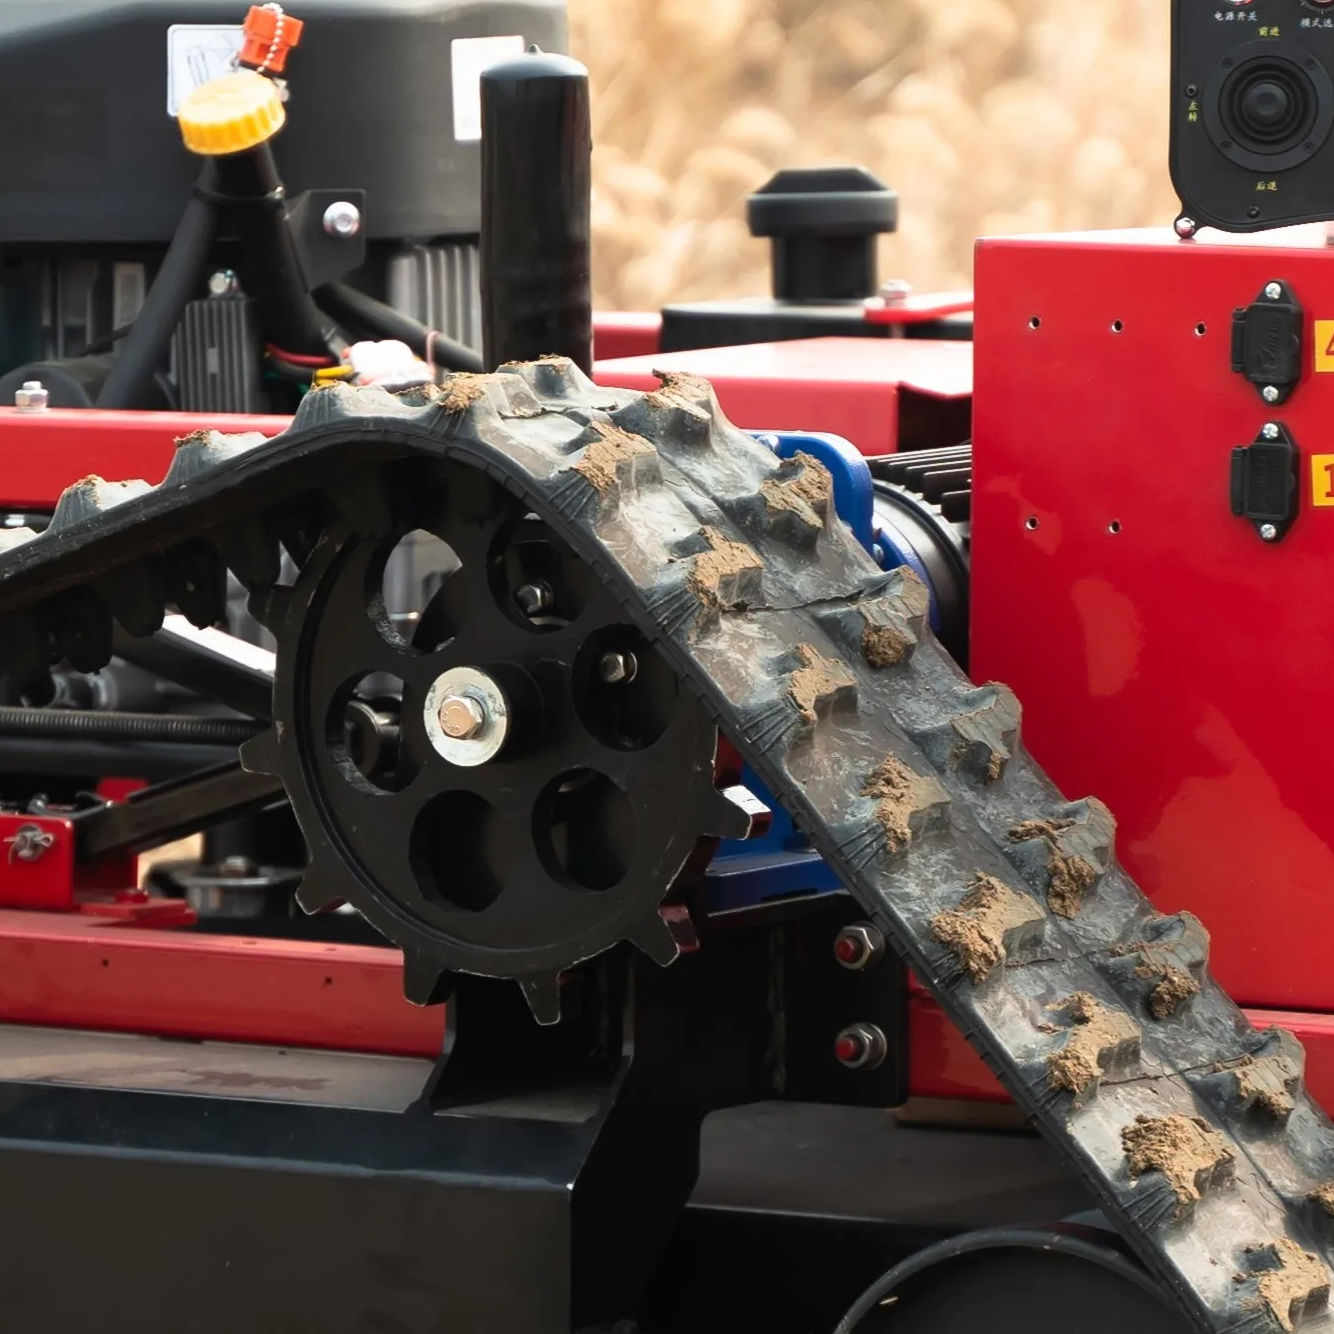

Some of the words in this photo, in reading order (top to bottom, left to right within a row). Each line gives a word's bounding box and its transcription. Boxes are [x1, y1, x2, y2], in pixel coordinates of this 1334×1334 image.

[1214, 11, 1258, 21] 电源开关
[1258, 26, 1280, 36] 前进
